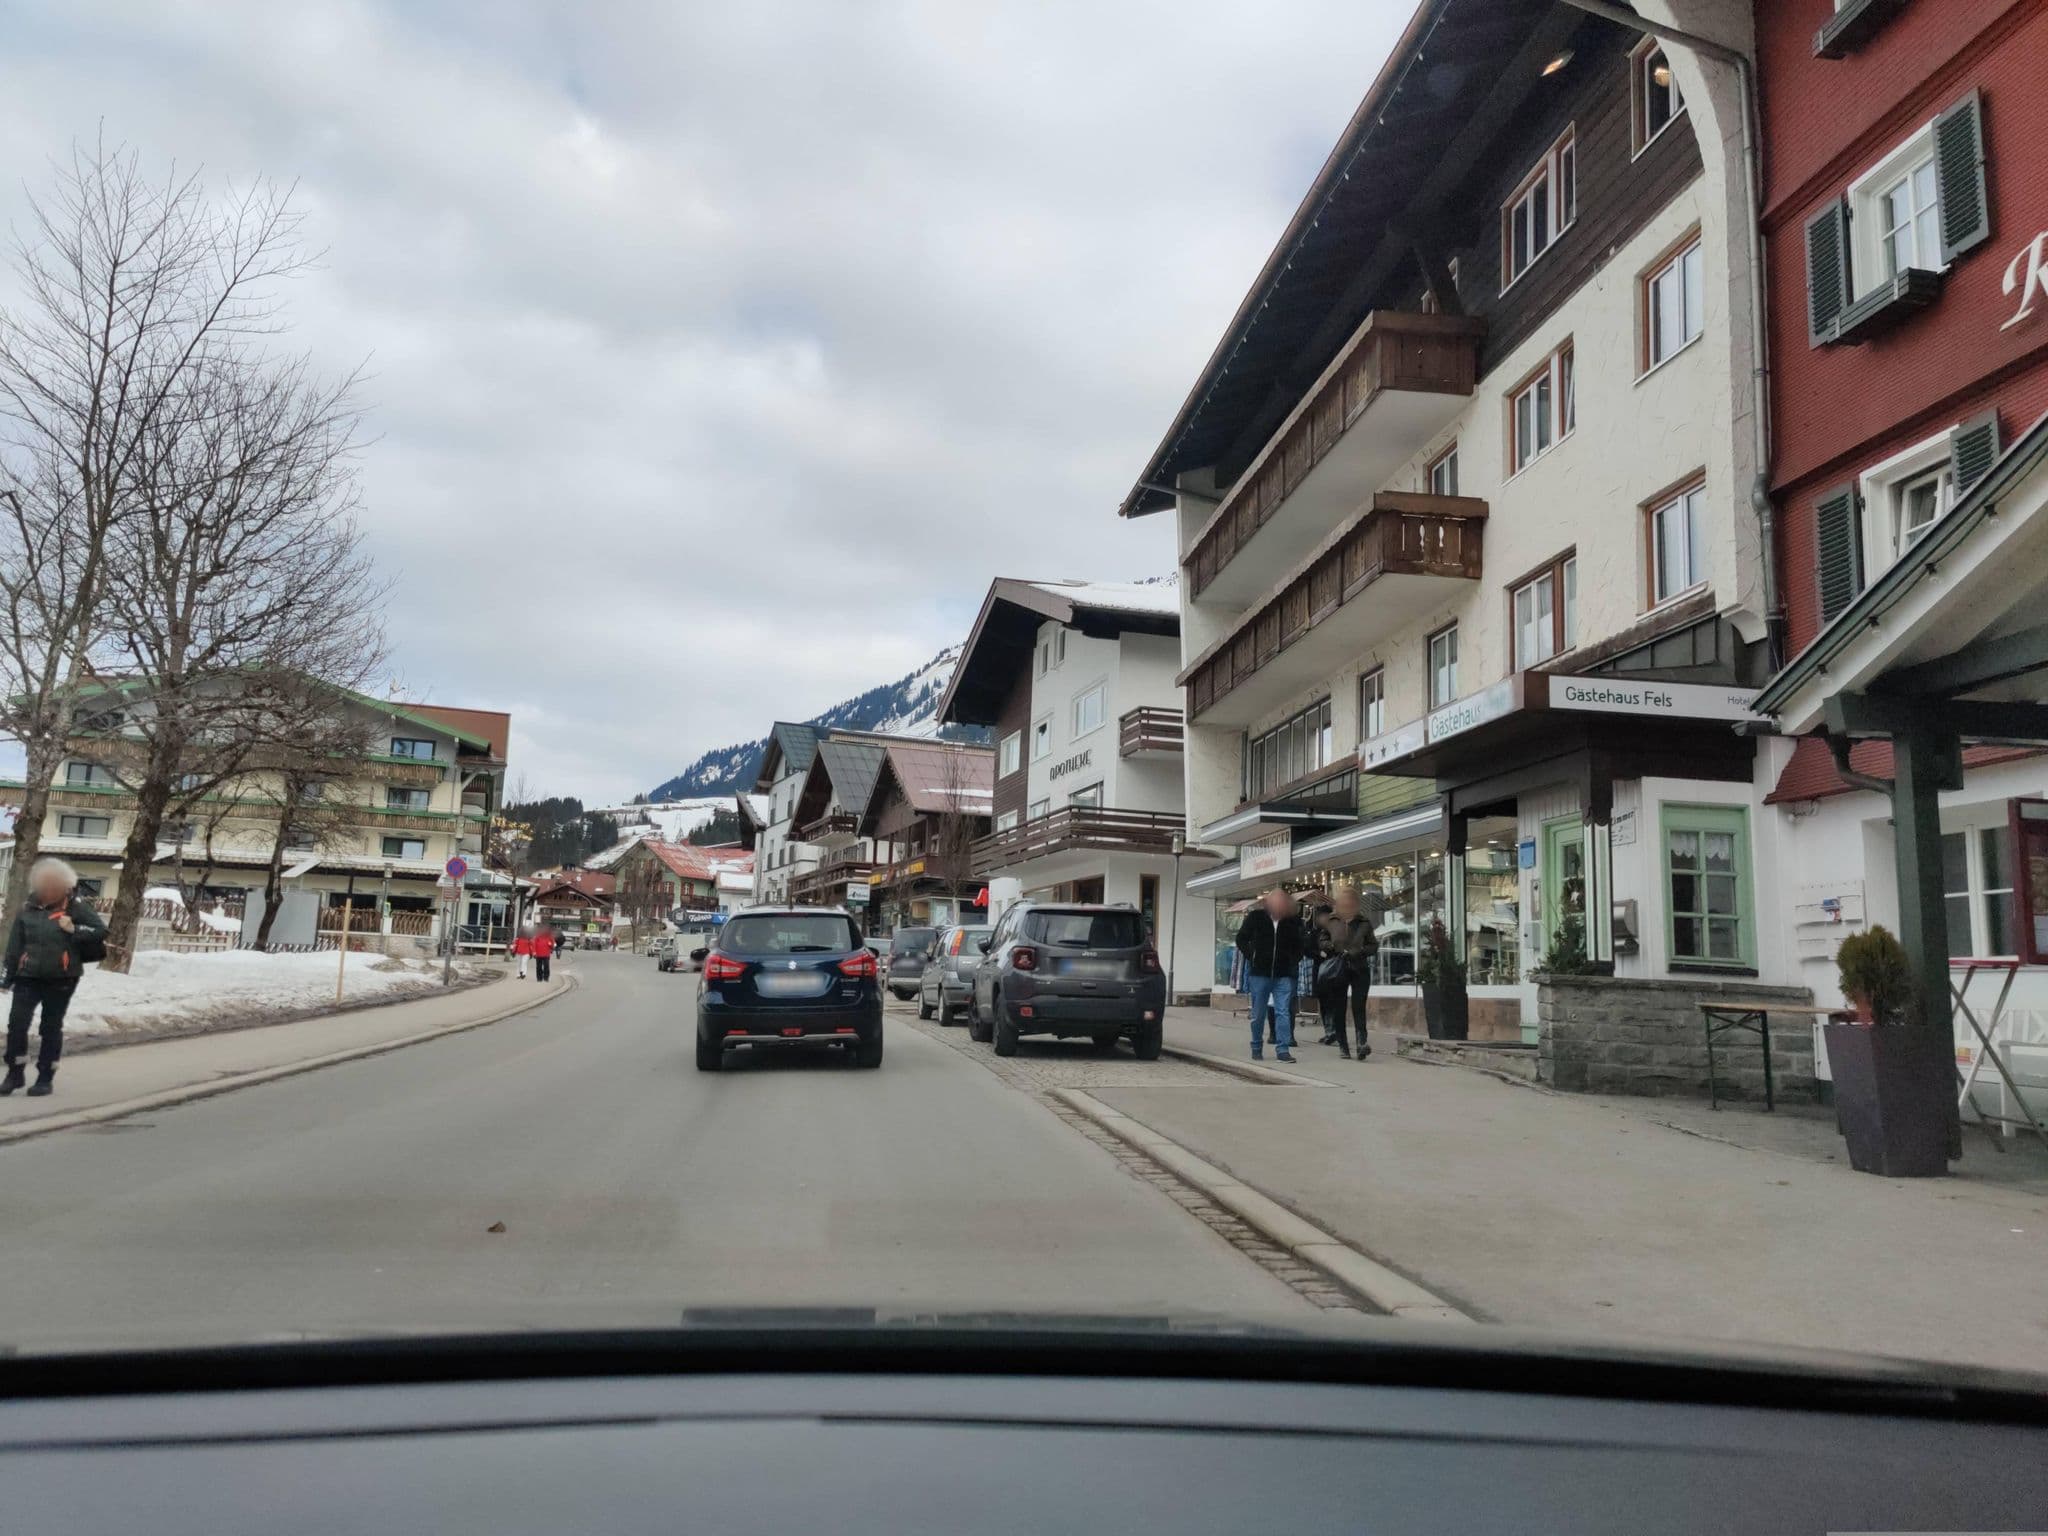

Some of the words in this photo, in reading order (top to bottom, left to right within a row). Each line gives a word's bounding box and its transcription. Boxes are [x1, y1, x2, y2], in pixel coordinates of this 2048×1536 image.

[1565, 686, 1640, 705] Gästehaus
[1644, 690, 1673, 708] Fels
[1049, 749, 1092, 781] APOTHEKE
